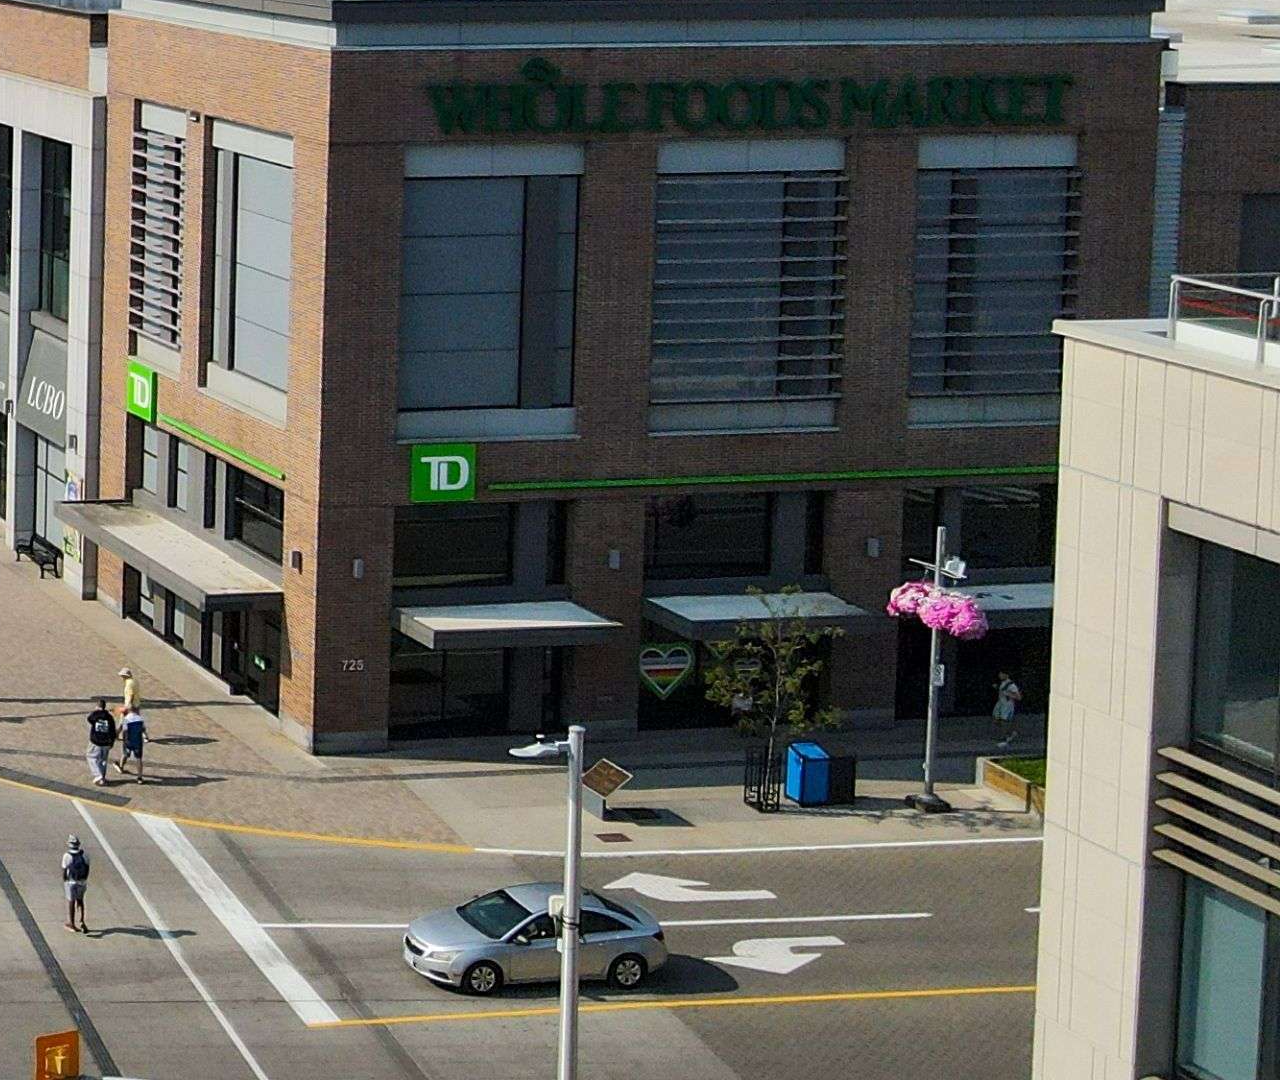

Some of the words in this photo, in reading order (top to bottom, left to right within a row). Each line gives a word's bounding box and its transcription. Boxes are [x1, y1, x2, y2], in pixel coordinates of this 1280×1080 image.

[425, 80, 640, 134] WHOLE
[644, 78, 830, 132] FOODS
[840, 73, 1074, 127] MARKET
[27, 375, 65, 421] LCBO
[129, 371, 150, 409] TD
[420, 455, 470, 491] TD
[342, 659, 364, 672] 725
